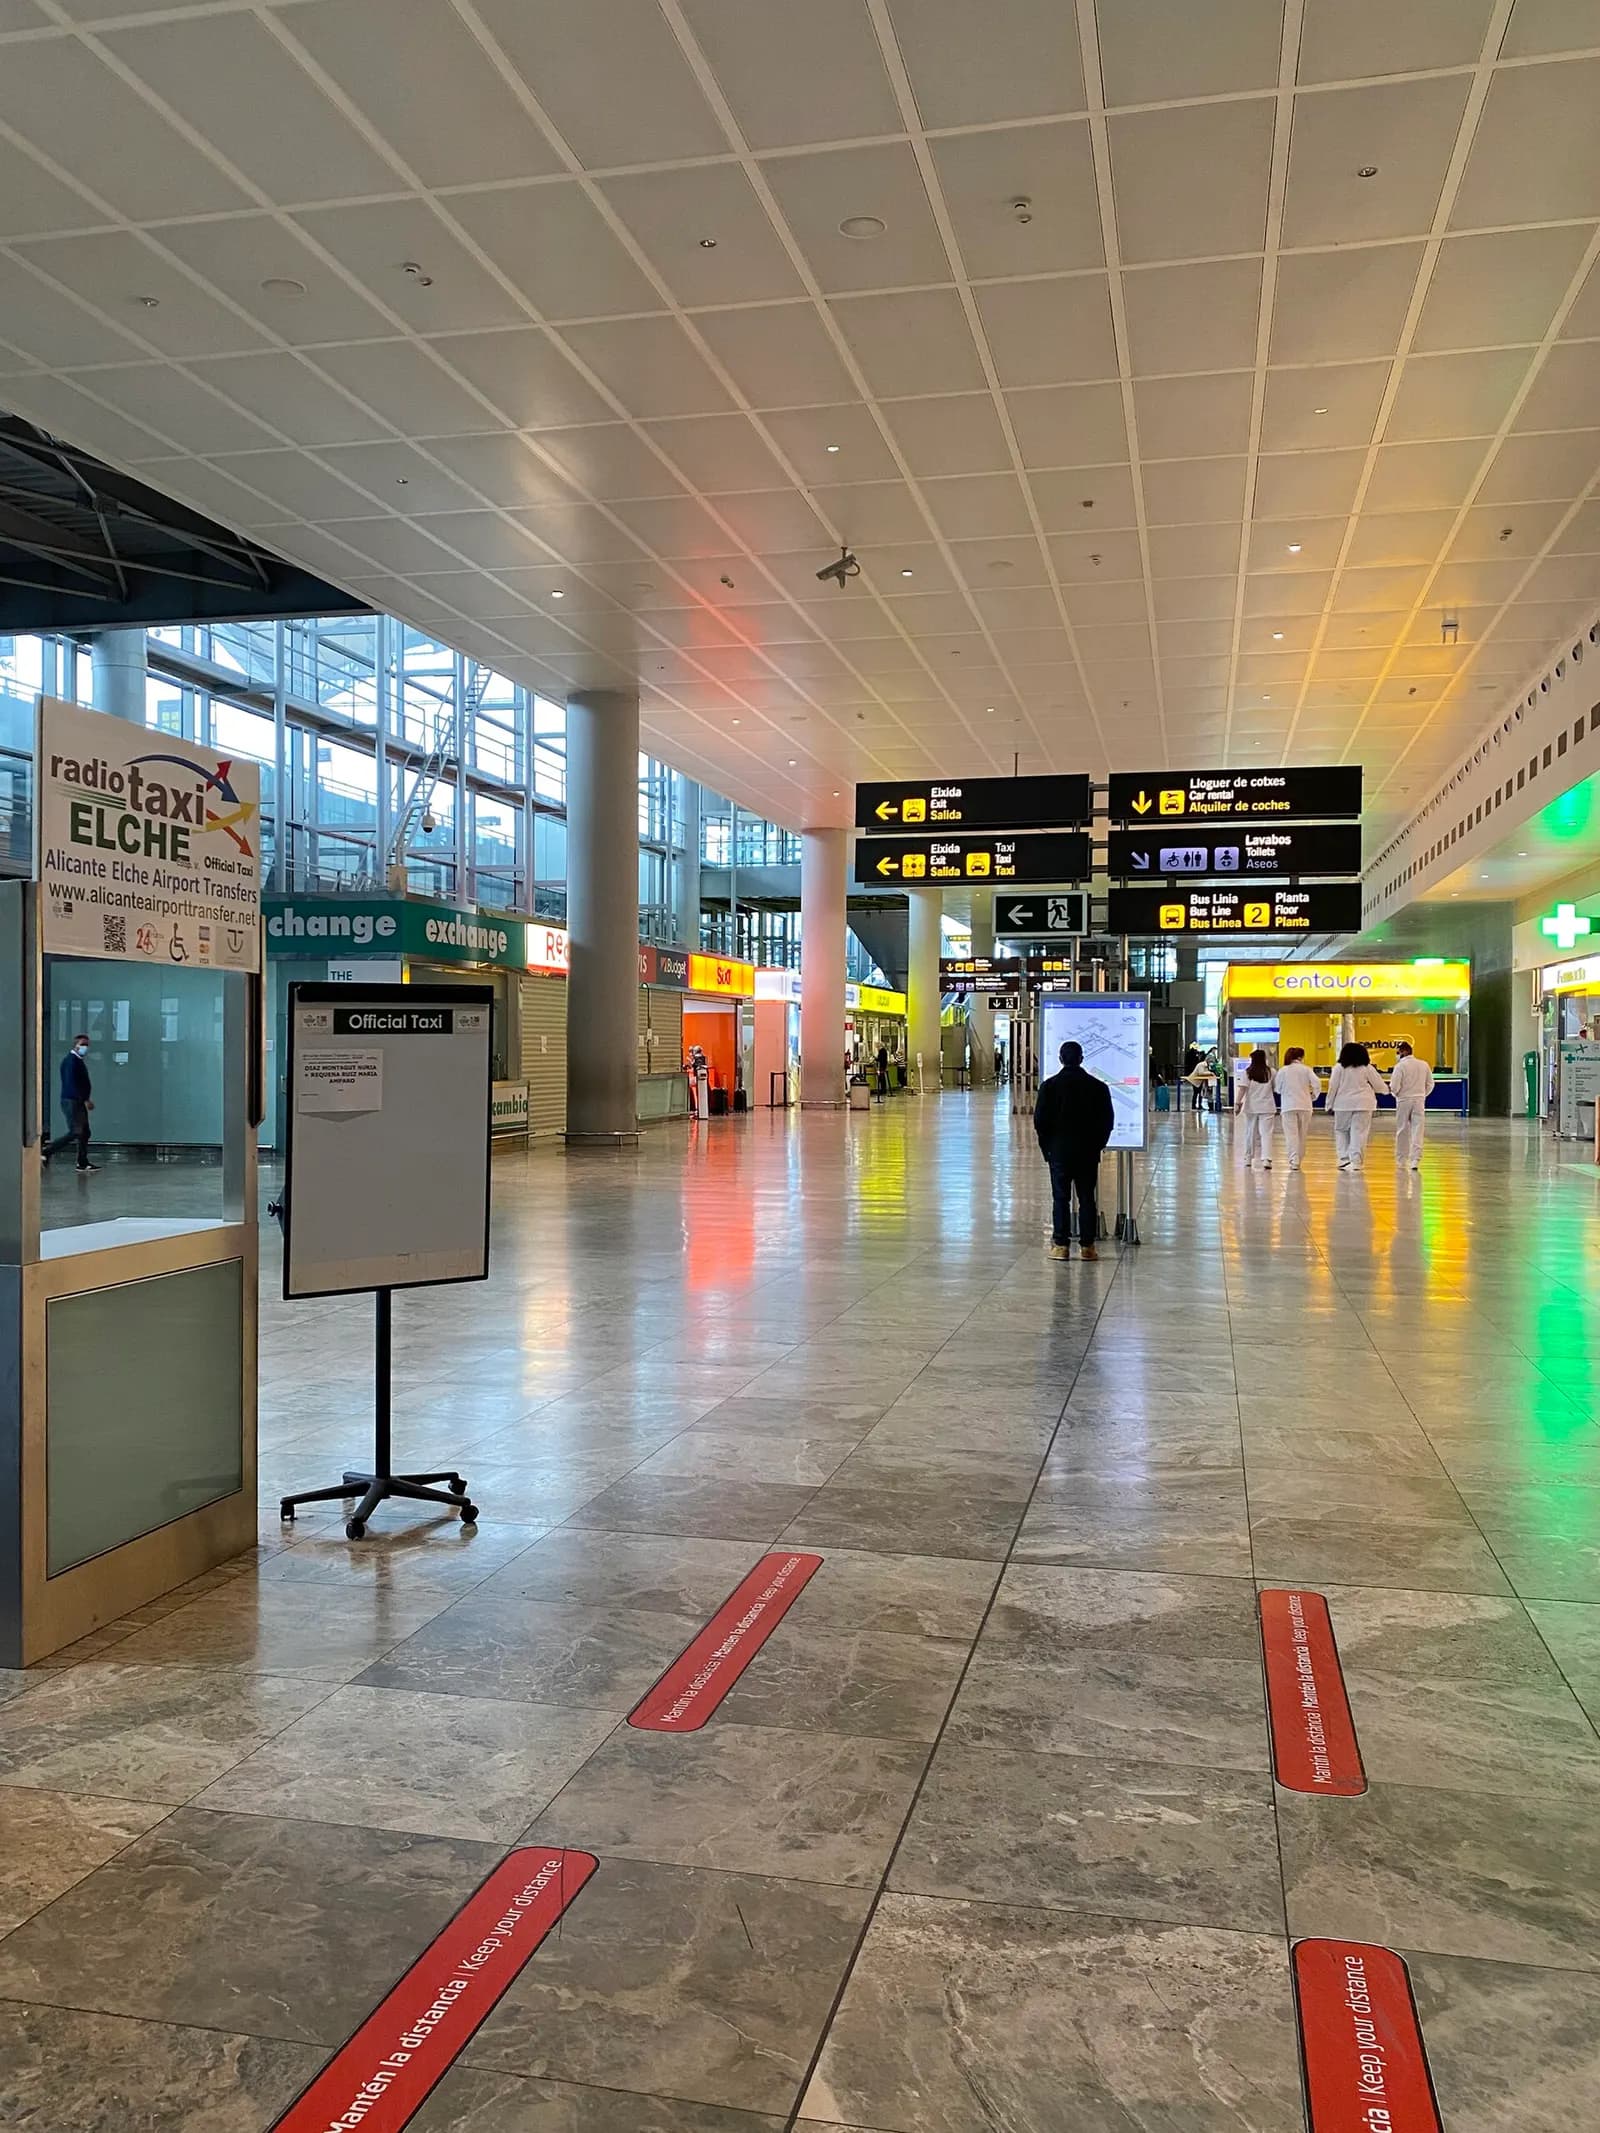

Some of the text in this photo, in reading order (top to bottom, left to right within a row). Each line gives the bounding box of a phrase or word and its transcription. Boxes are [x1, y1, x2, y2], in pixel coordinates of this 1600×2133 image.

[1190, 776, 1286, 791] Lloguer de cotxes
[930, 787, 962, 798] Eixida
[1189, 790, 1234, 800] Car rental
[930, 799, 947, 809] Exit
[1189, 800, 1290, 814] Alquiler de coches
[930, 809, 962, 820] Salida
[71, 801, 190, 862] ELCHE
[1245, 835, 1291, 846] Lavabos
[930, 844, 961, 854] Eixida
[995, 842, 1015, 852] Taxi
[1245, 847, 1276, 858] Toilets
[930, 855, 946, 865] Exit
[995, 854, 1011, 864] Taxi
[1246, 858, 1279, 869] Aseos
[204, 856, 254, 877] Official Taxi
[930, 866, 960, 877] Salida
[995, 865, 1015, 876] Taxi
[45, 849, 257, 903] Alicante Elche Airport Transfers
[1190, 894, 1210, 905] Bus
[1275, 892, 1309, 904] Planta
[48, 882, 257, 926] www.alicanteairporttransfer.net
[1190, 906, 1231, 917] Bus Line
[1251, 908, 1263, 923] 2
[1275, 905, 1299, 915] Floor
[1190, 918, 1210, 928] Bus
[1275, 916, 1309, 928] Planta
[426, 913, 507, 959] exchange
[667, 957, 687, 980] Budget
[330, 970, 352, 981] THE
[1273, 973, 1372, 989] centauro
[348, 1013, 407, 1029] Official
[411, 1013, 442, 1029] Taxi
[379, 2051, 413, 2068] la
[399, 1979, 467, 2050] distancia
[459, 1932, 504, 1971] Keep
[491, 1908, 524, 1937] your
[512, 1859, 562, 1907] distance
[1344, 1956, 1372, 2014] distance
[1353, 2016, 1385, 2052] your
[1357, 2054, 1387, 2095] Keep
